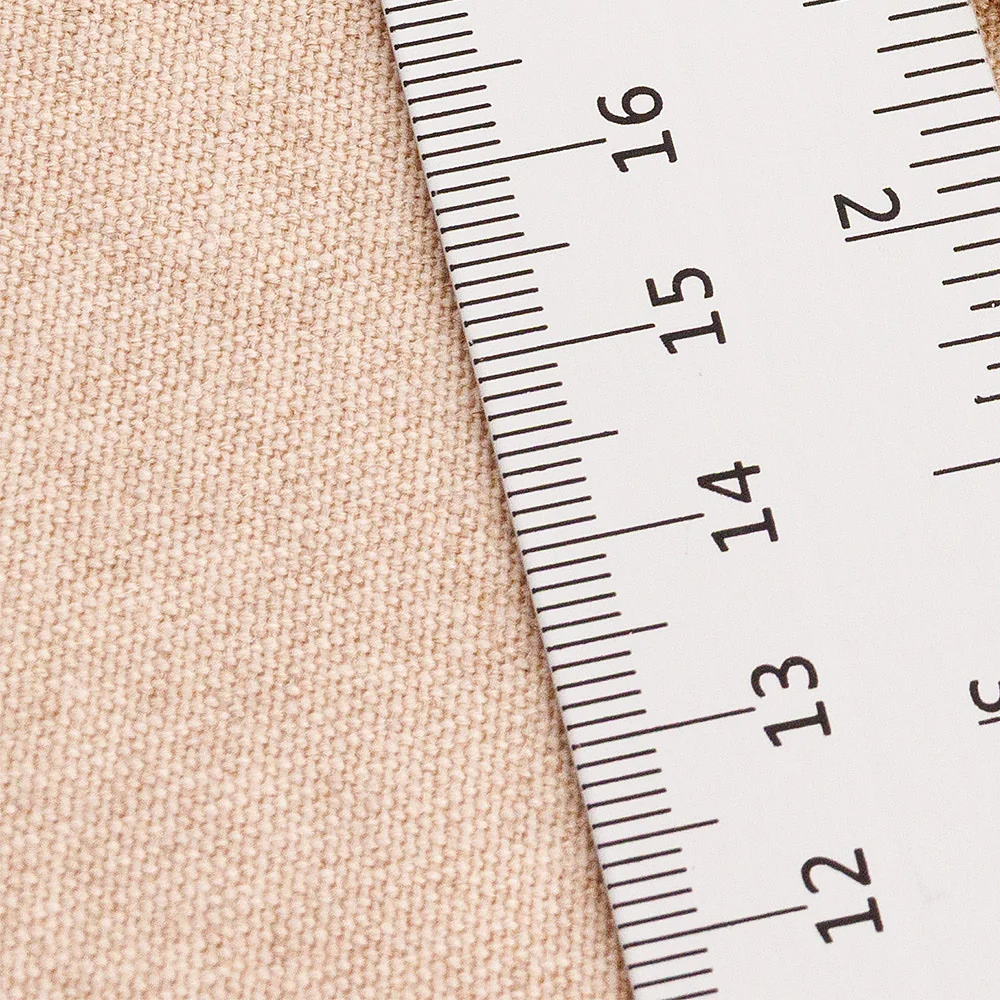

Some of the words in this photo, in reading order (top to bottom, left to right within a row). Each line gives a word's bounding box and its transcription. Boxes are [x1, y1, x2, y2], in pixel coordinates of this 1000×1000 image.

[597, 85, 678, 173] 16
[834, 186, 901, 231] 2
[645, 267, 726, 354] 15
[697, 461, 779, 554] 14
[751, 655, 831, 748] 13
[800, 847, 884, 944] 12
